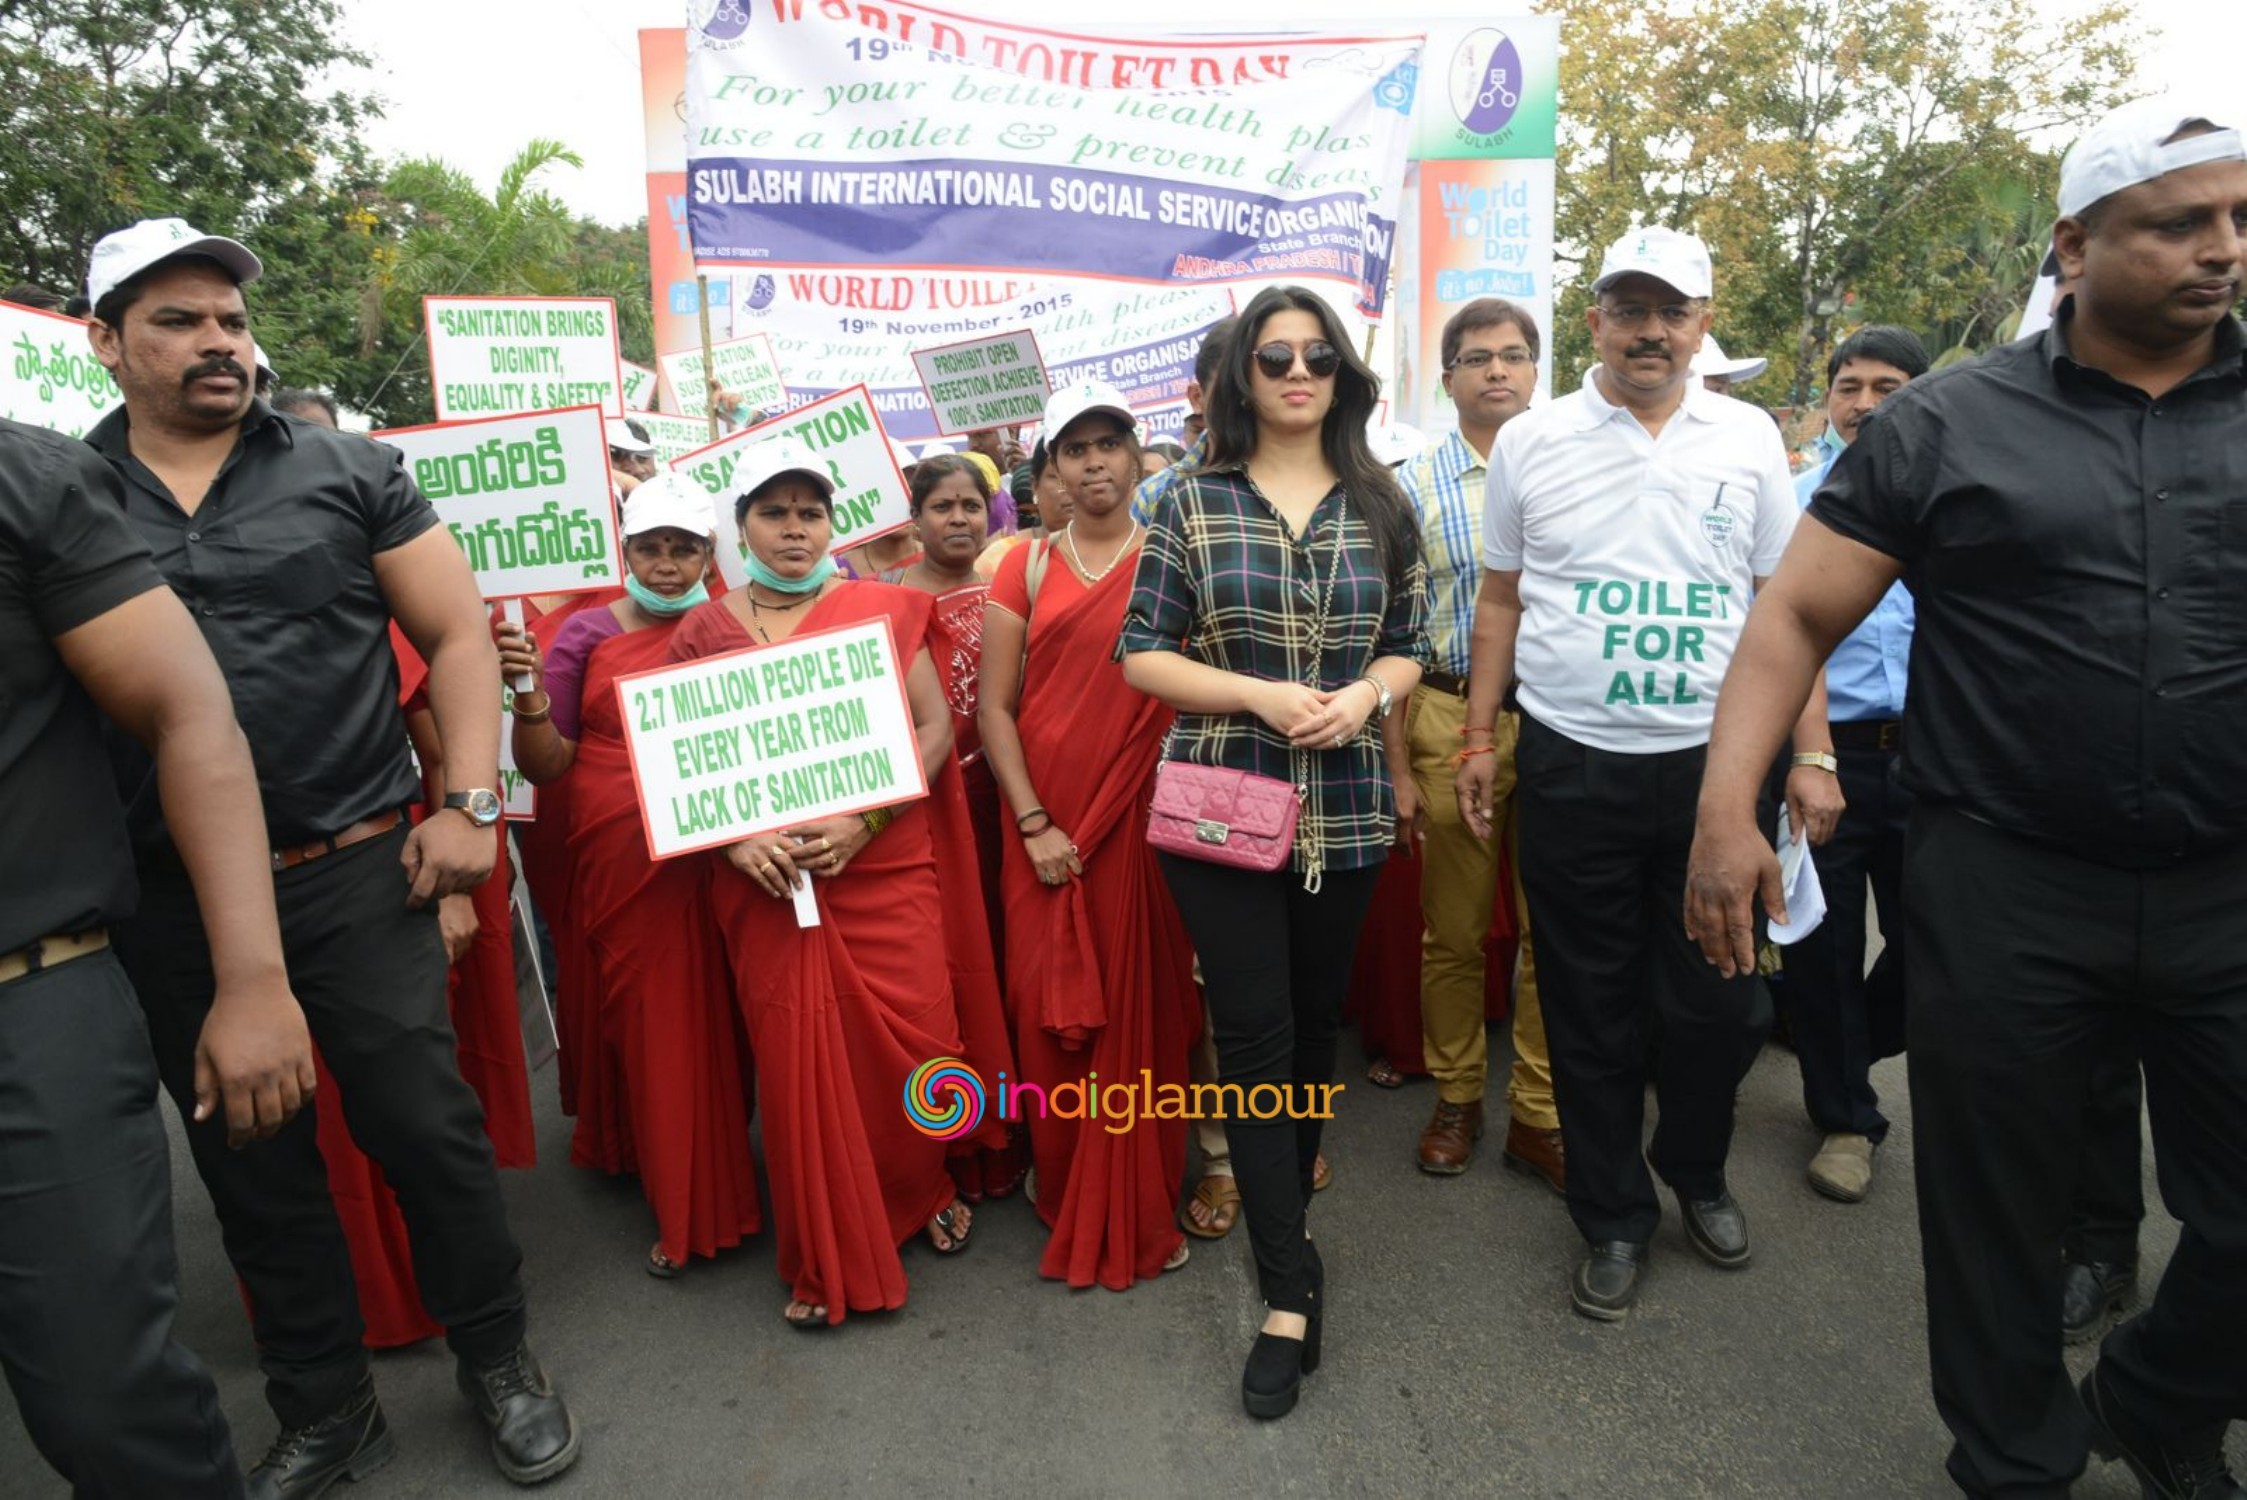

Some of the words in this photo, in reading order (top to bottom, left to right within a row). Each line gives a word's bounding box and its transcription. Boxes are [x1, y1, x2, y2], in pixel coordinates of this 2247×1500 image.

[711, 75, 804, 106] For
[812, 80, 927, 116] your
[1115, 96, 1262, 138] health
[699, 128, 773, 147] use
[795, 131, 826, 149] a
[847, 119, 973, 150] toilet
[998, 122, 1058, 150] &
[1067, 133, 1247, 178] prevent
[1455, 127, 1514, 149] SULABH
[694, 169, 802, 204] SULABH
[812, 170, 1041, 208] INTERNATIONAL
[1049, 177, 1151, 220] SOCIAL
[1158, 190, 1262, 238] SERVICE
[1438, 180, 1528, 214] World
[1443, 210, 1531, 239] Toilet
[1258, 240, 1304, 253] State
[1308, 233, 1362, 252] Branch
[1484, 240, 1528, 266] Day
[1172, 253, 1251, 279] ANDHRA
[1253, 248, 1341, 272] PRADESH
[788, 274, 915, 311] WORLD
[546, 309, 605, 336] BRINGS
[838, 317, 878, 334] 19th
[886, 317, 1000, 335] November
[1020, 294, 1072, 318] 2015
[489, 346, 564, 378] DIGINITY,
[732, 362, 773, 386] CLEAN
[933, 347, 987, 376] PROHIBIT
[986, 341, 1019, 365] OPEN
[1047, 360, 1108, 389] ERVICE
[1139, 367, 1182, 384] Branch
[445, 383, 524, 412] EQUALITY
[531, 382, 543, 409] &
[930, 374, 992, 403] DEFECTION
[992, 365, 1042, 393] ACHIEVE
[976, 393, 1043, 422] SANITATION
[1574, 580, 1731, 619] TOILET
[1602, 624, 1705, 662] FOR
[670, 666, 760, 724] MILLION
[761, 647, 846, 702] PEOPLE
[845, 637, 885, 683] DIE
[1604, 670, 1699, 705] ALL
[672, 725, 742, 779] EVERY
[746, 711, 808, 762] YEAR
[806, 697, 870, 748] FROM
[671, 785, 733, 837] LACK
[733, 778, 761, 820] OF
[767, 747, 895, 814] SANITATION
